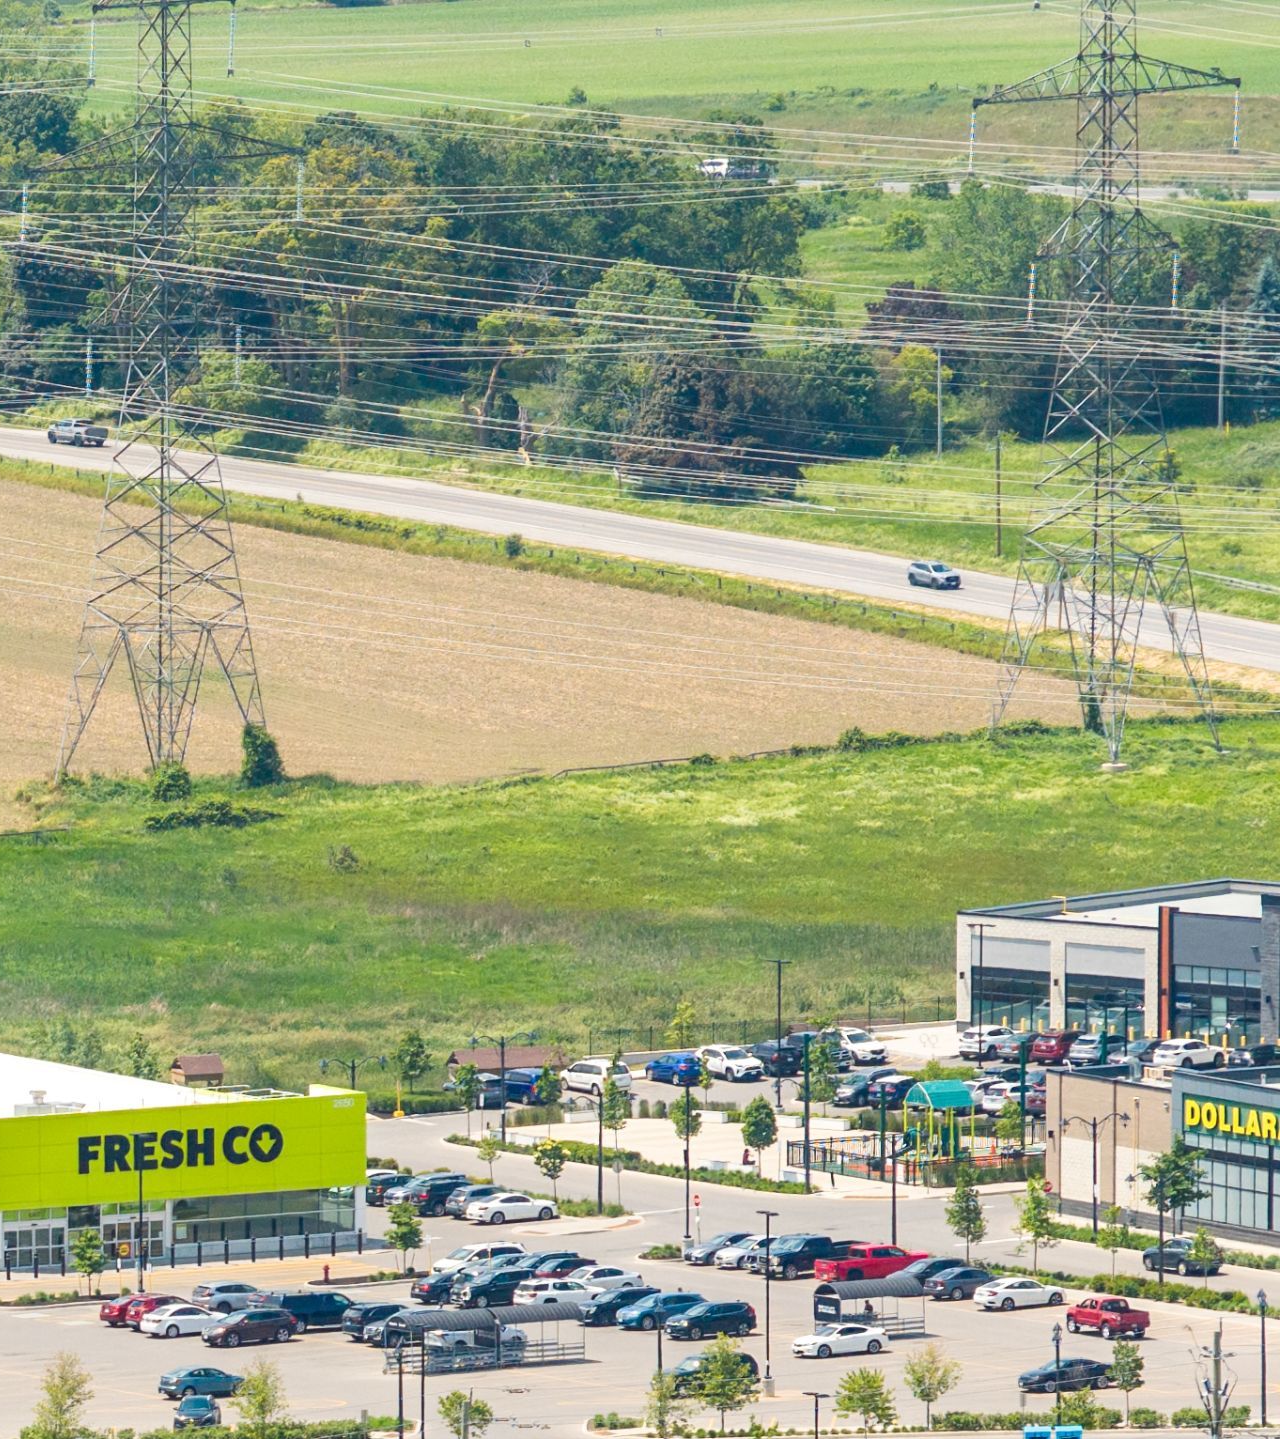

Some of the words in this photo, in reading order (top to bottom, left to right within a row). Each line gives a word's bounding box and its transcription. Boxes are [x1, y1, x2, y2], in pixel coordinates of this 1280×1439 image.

[1184, 1098, 1280, 1141] DOLLAR
[77, 1127, 215, 1175] FRESH
[222, 1123, 284, 1166] CO
